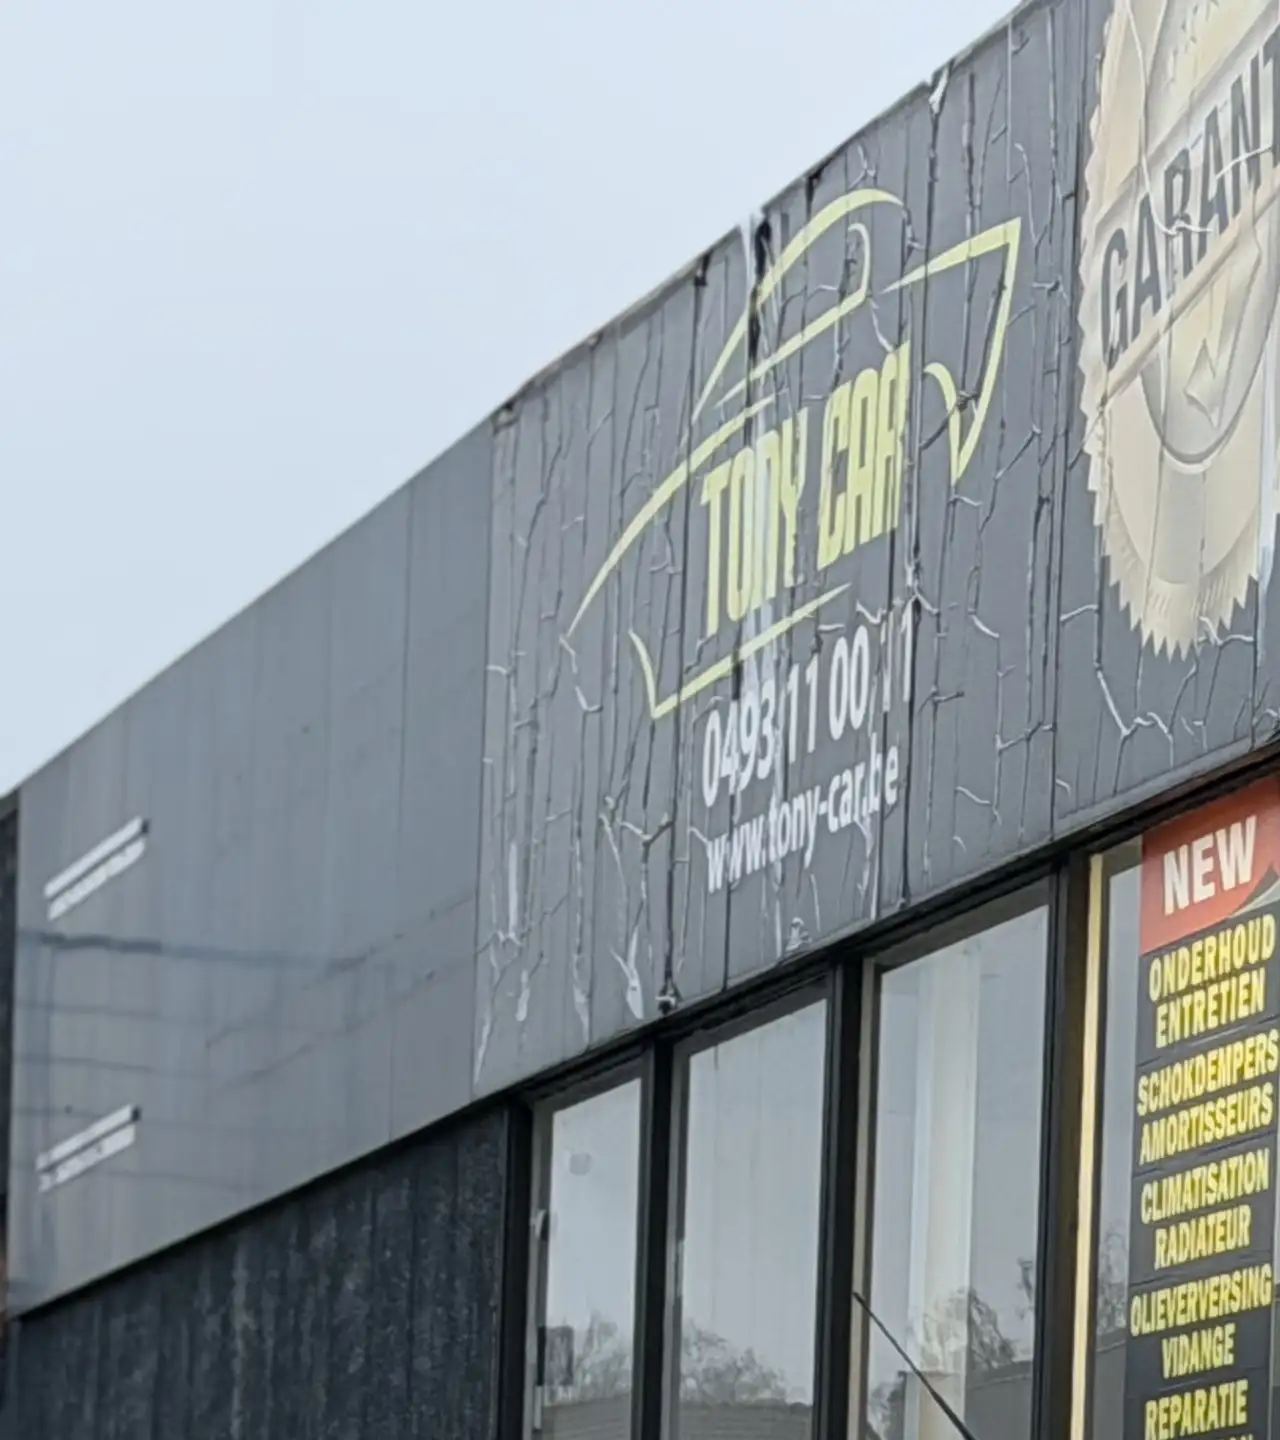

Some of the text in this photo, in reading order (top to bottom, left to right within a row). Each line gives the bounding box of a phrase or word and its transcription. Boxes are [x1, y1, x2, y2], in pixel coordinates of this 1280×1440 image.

[701, 340, 910, 637] TONY CAR
[702, 678, 776, 808] 0493
[829, 625, 869, 741] 00
[1162, 816, 1257, 914] NEW
[1149, 913, 1276, 1003] ONDERHOUD
[1155, 967, 1266, 1049] ENTRETIEN
[1137, 1028, 1279, 1117] SCHOKDEMPERS
[1139, 1082, 1273, 1166] AMORTISSEURS
[1141, 1148, 1270, 1225] CLIMATISATION
[1154, 1204, 1251, 1271] RADIATEUR
[1130, 1263, 1273, 1337] OLIEVERVERSING
[1162, 1322, 1236, 1380] VIDANGE
